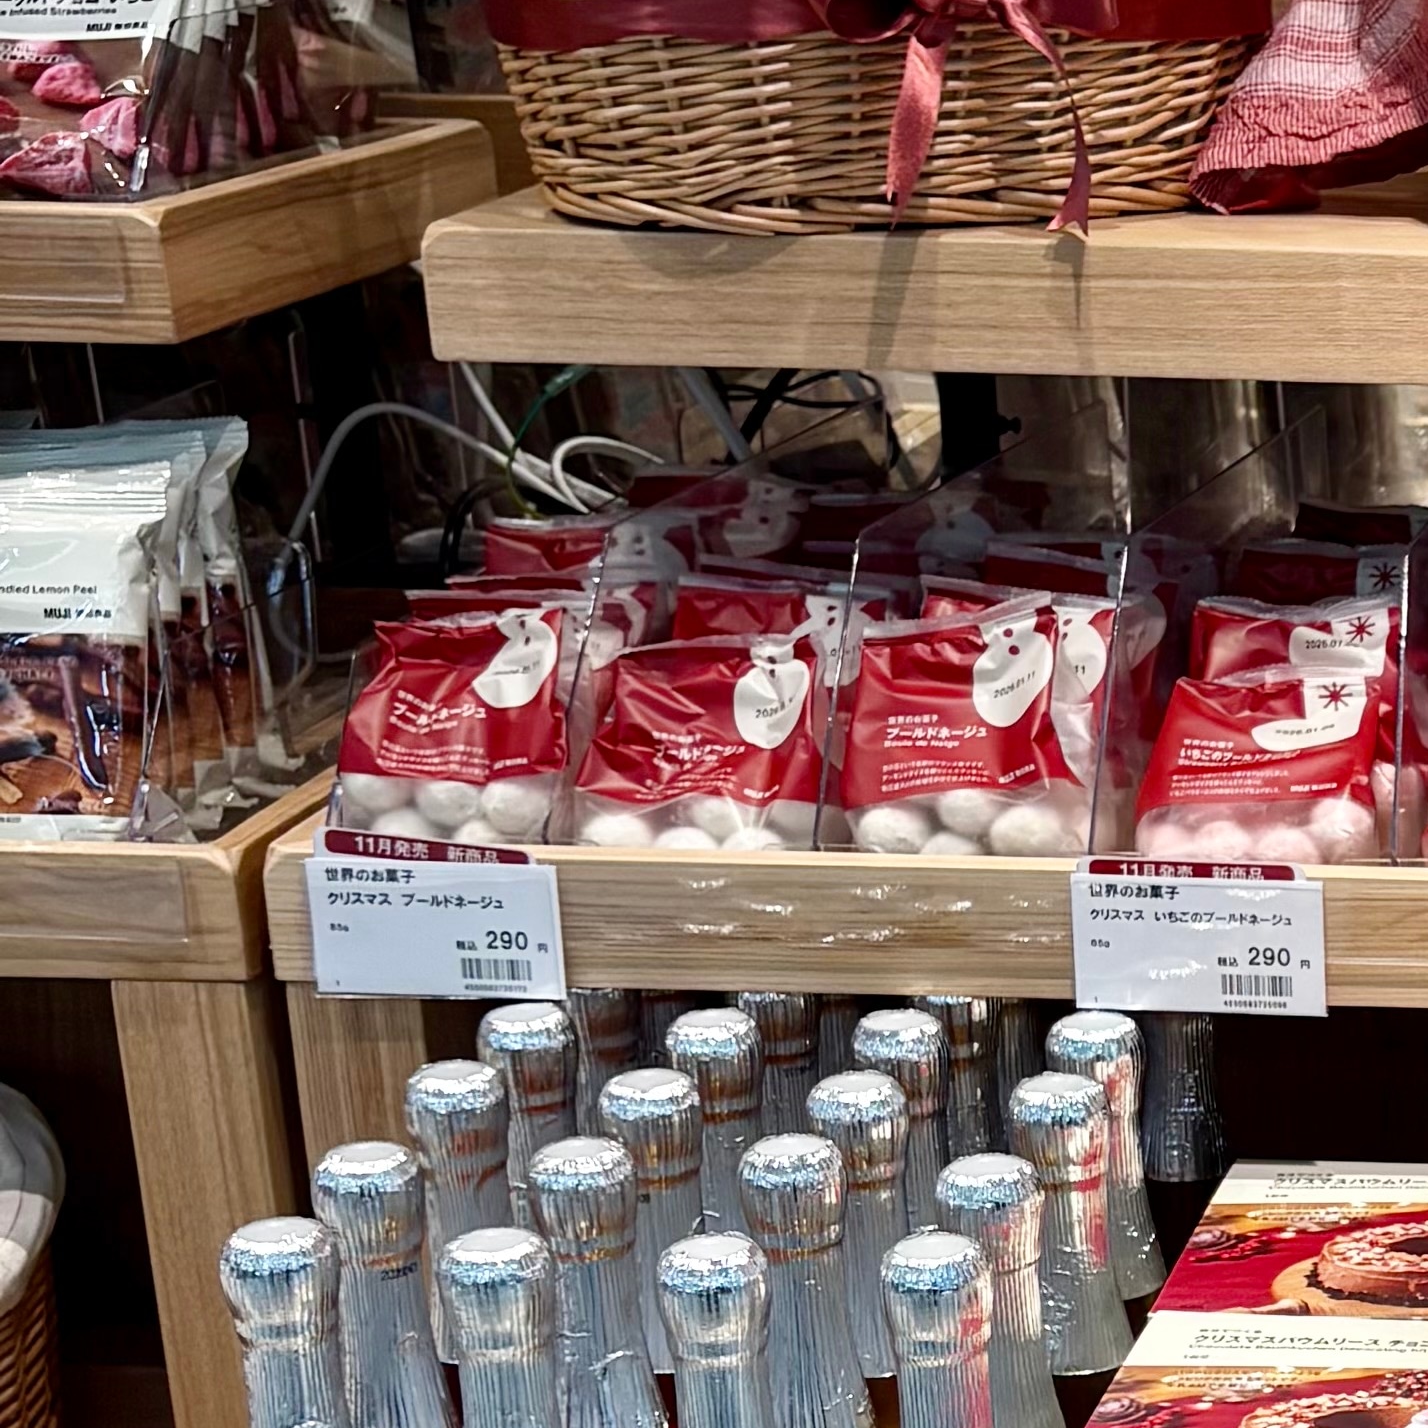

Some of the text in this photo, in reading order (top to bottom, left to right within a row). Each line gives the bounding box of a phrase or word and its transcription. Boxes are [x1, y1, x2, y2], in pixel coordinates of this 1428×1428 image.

[326, 866, 416, 884] 世界のお菓子
[327, 891, 392, 908] クリスマス
[1089, 882, 1180, 901] 世界のお菓子
[1090, 908, 1145, 923] クリスマス
[486, 929, 529, 951] 290
[1248, 946, 1291, 968] 290
